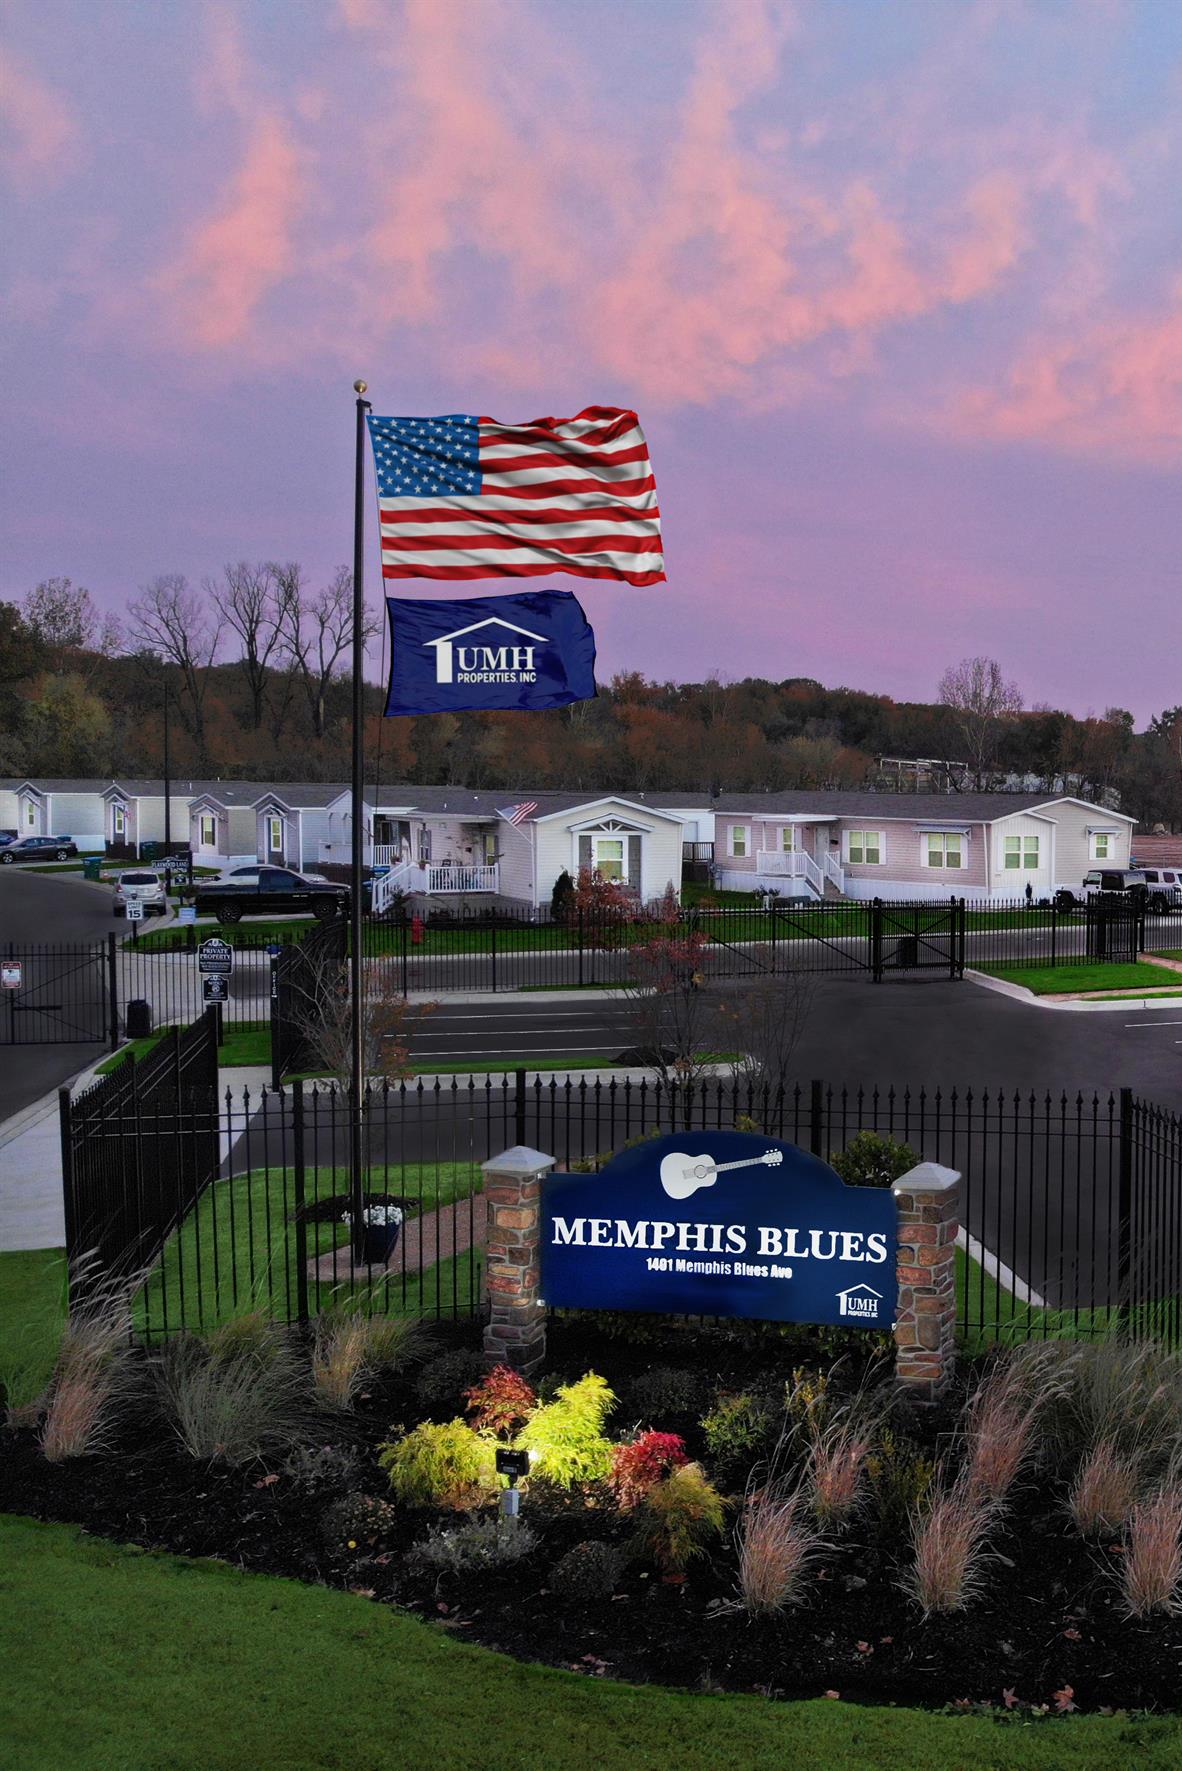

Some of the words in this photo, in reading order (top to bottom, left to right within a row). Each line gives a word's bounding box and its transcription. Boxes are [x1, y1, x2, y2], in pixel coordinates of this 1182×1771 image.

[456, 646, 536, 671] UMH
[519, 672, 537, 683] INC
[127, 910, 141, 918] 15
[551, 1216, 747, 1254] MEMPHIS
[756, 1226, 888, 1264] BLUES
[646, 1257, 674, 1272] 1401
[675, 1258, 732, 1275] Memphis
[733, 1261, 769, 1278] Blues
[769, 1264, 793, 1279] Ave
[847, 1297, 879, 1312] UMH
